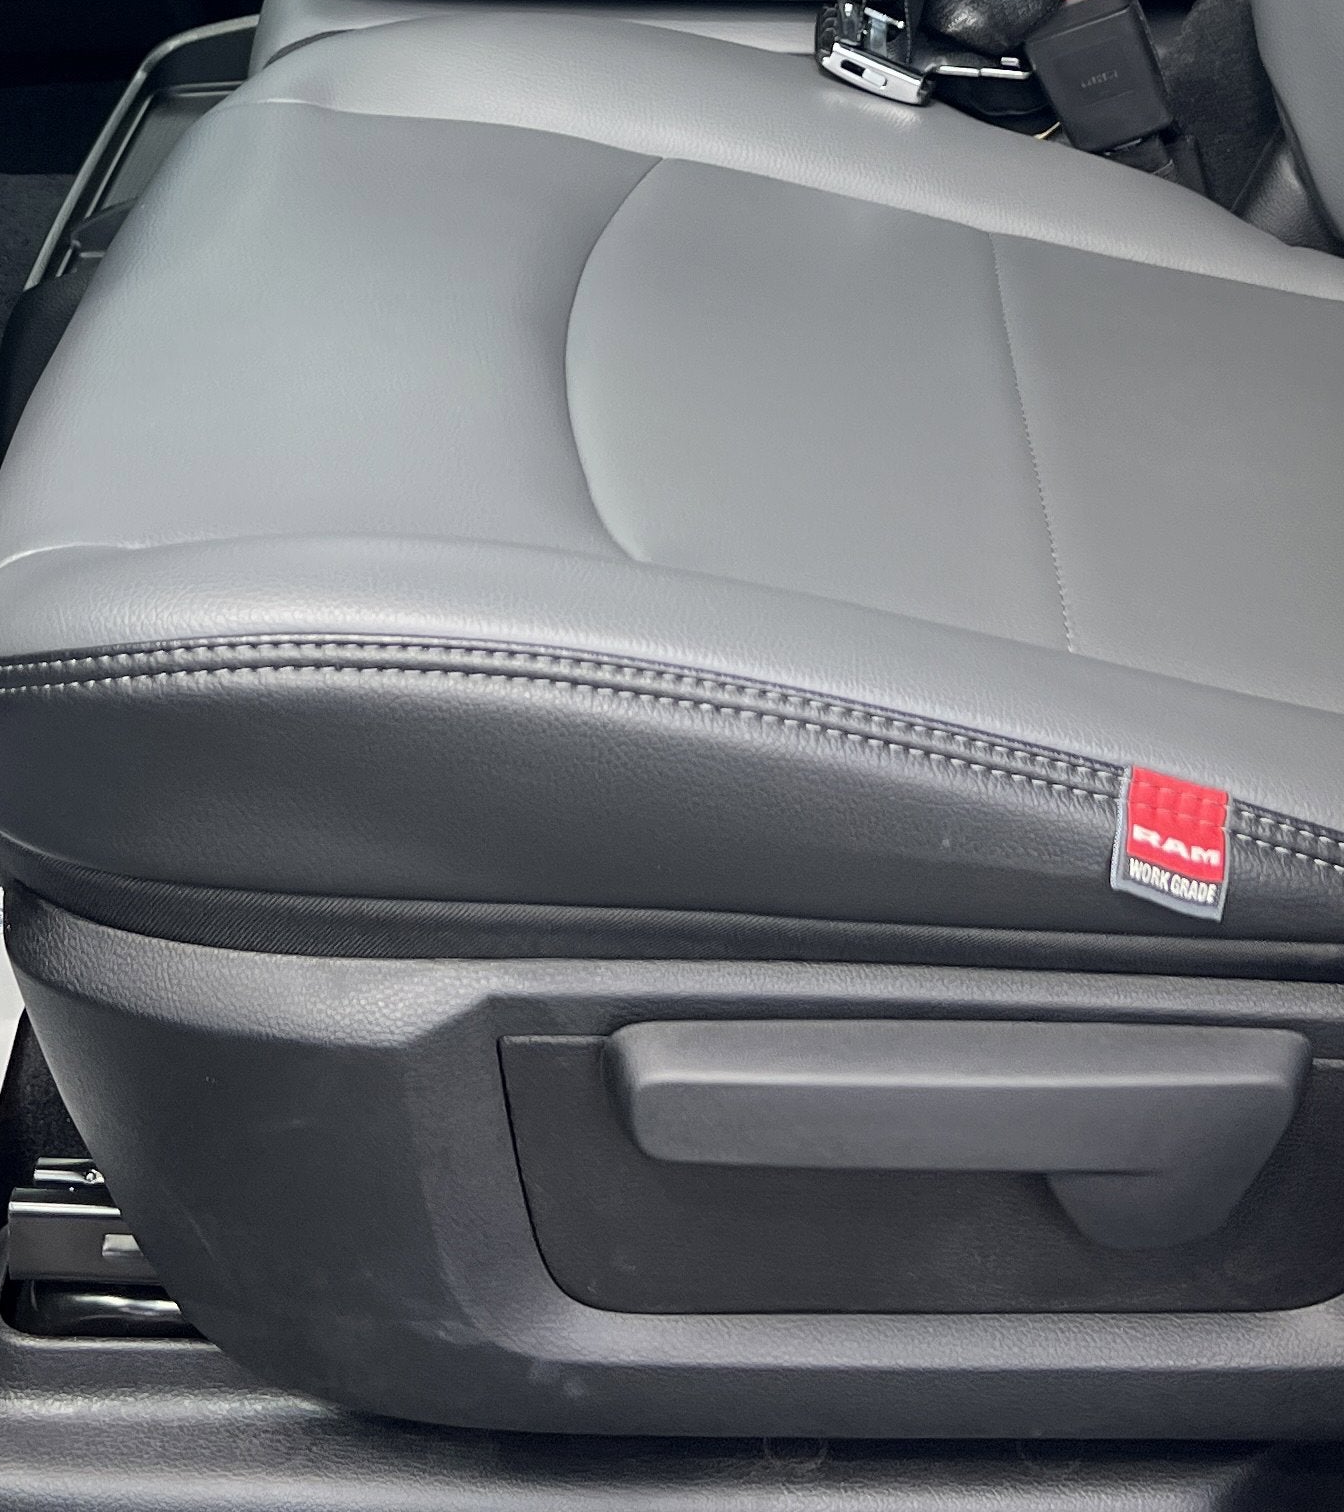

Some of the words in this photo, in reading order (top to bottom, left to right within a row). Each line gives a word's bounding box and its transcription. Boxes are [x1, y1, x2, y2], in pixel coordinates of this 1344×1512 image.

[1132, 823, 1222, 867] RAM
[1128, 857, 1171, 892] WORK
[1170, 873, 1218, 905] GRADE
